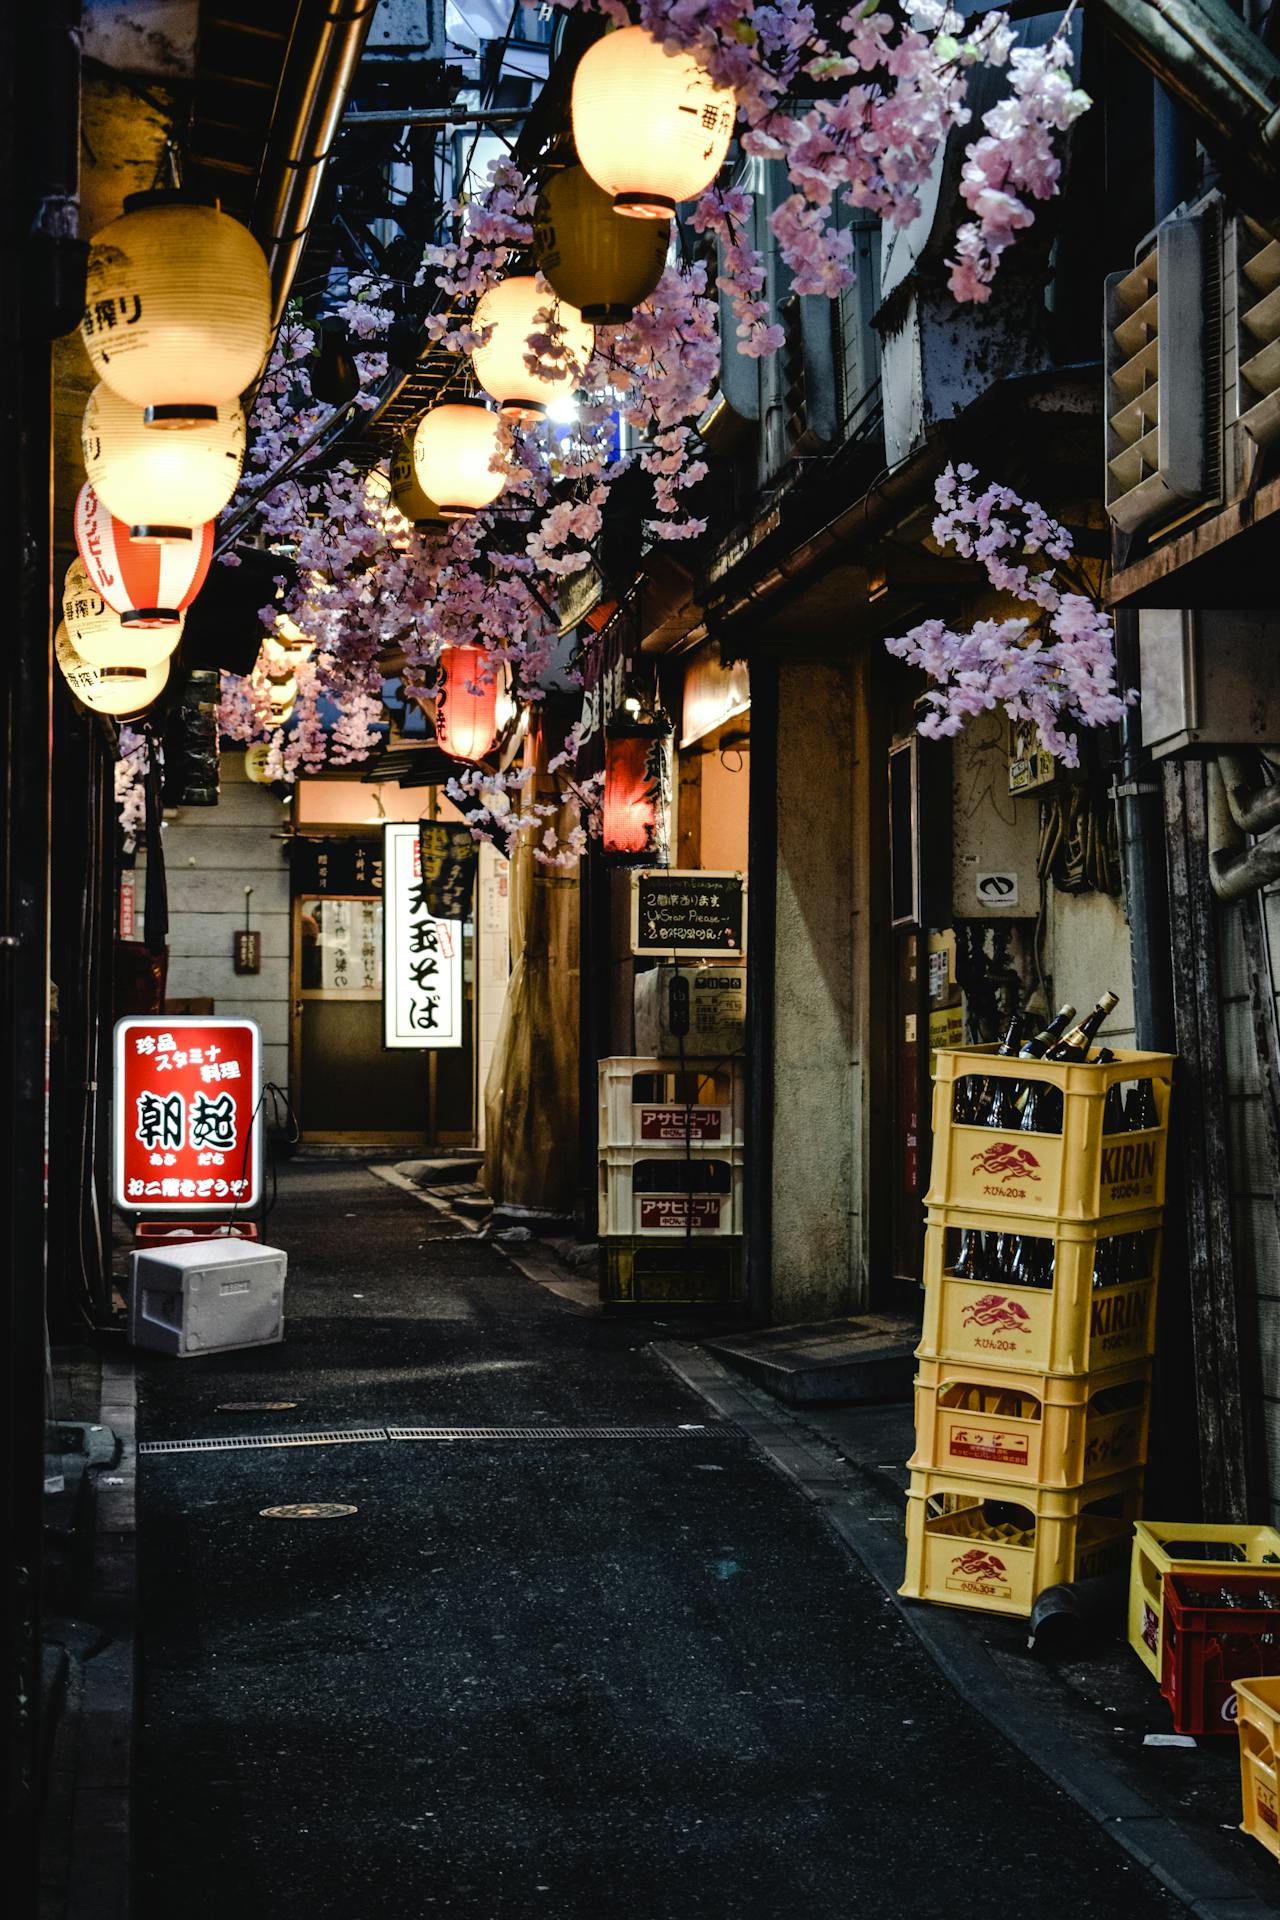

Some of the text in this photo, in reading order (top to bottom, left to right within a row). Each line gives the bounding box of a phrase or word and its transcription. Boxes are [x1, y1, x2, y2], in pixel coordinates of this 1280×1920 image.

[135, 1033, 176, 1055] 珍品
[155, 1045, 221, 1072] スタミナ
[200, 1061, 241, 1083] 料理
[1101, 1141, 1156, 1184] KIRIN
[983, 1184, 1026, 1199] 大びん20本
[1090, 1289, 1149, 1338] KIRIN
[974, 1337, 1017, 1351] 大びん20本
[954, 1430, 1024, 1447] ホッピー
